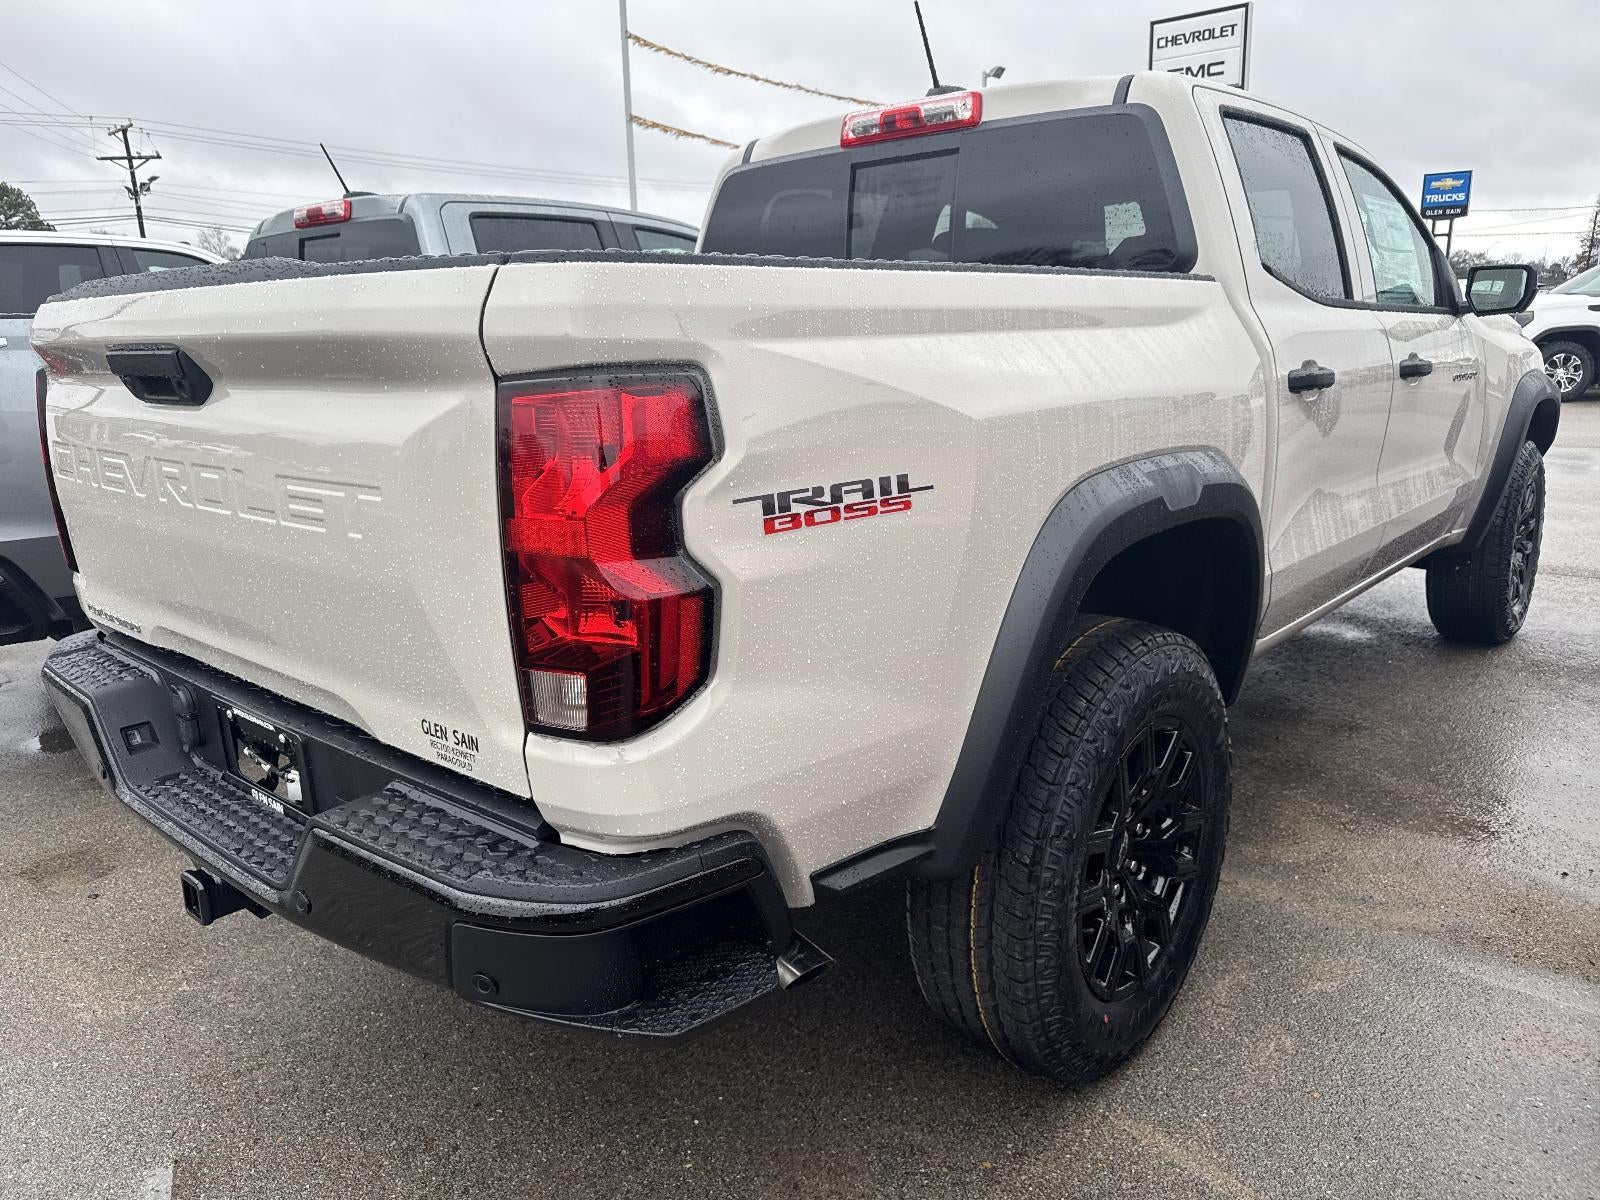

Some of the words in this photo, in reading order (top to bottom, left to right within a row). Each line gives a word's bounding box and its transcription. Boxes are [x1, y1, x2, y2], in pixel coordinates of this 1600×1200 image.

[1157, 24, 1237, 49] CHEVROLET
[1426, 193, 1466, 203] TRUCKS
[52, 440, 381, 539] CHEVROLET
[733, 473, 934, 516] TRAIL
[763, 494, 912, 535] BOSS
[421, 718, 448, 742] GLEN
[452, 729, 479, 753] SAIN
